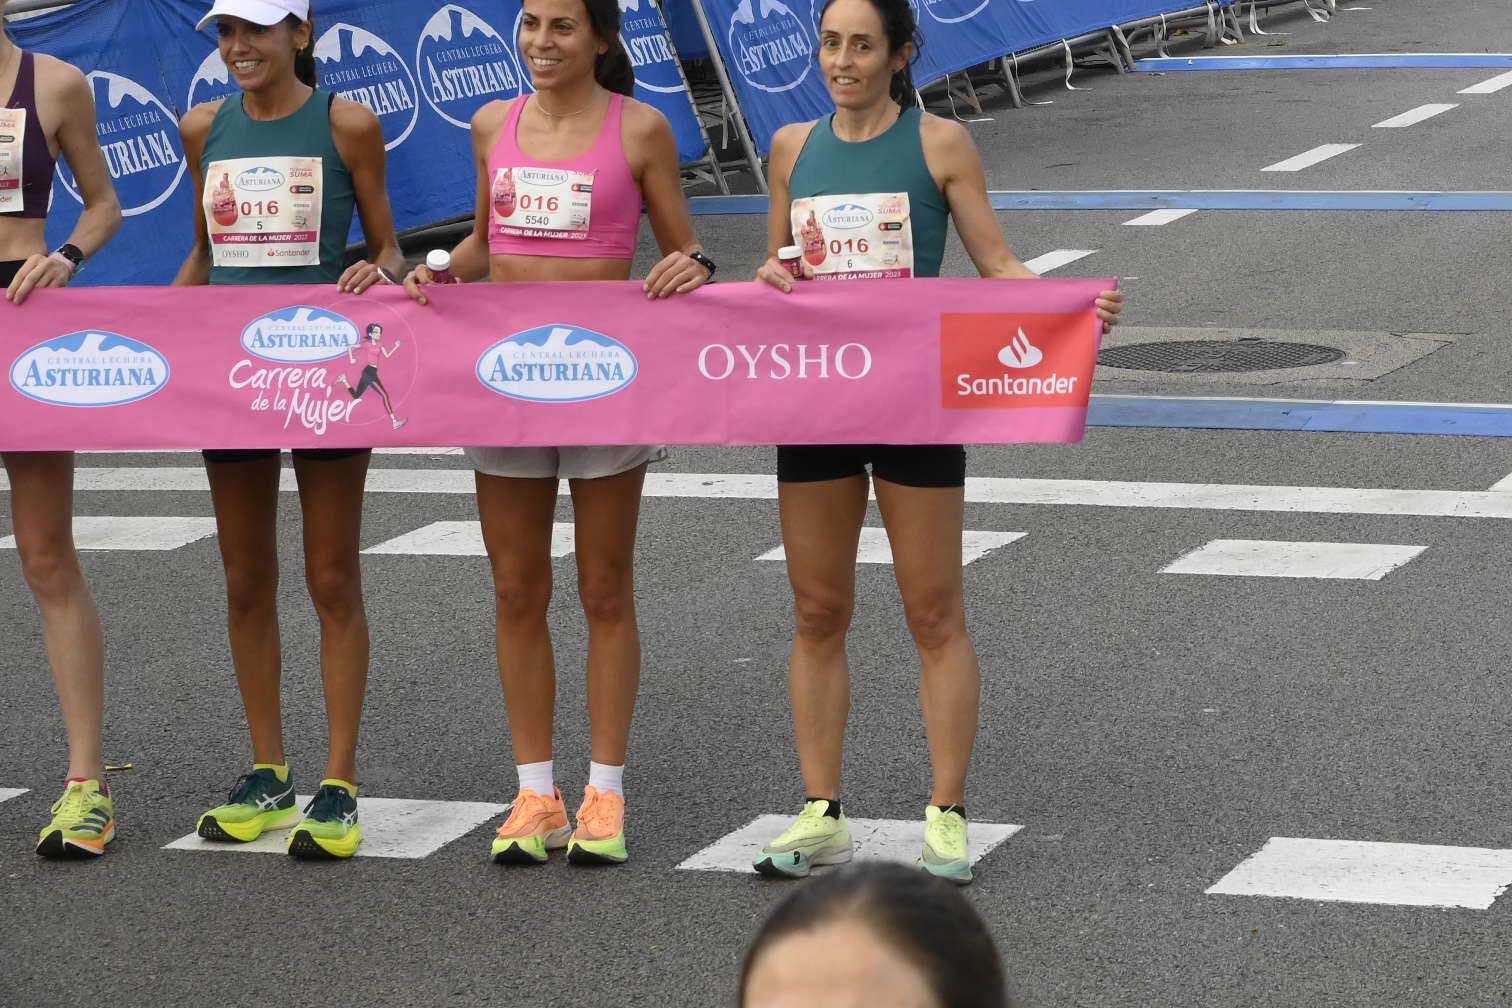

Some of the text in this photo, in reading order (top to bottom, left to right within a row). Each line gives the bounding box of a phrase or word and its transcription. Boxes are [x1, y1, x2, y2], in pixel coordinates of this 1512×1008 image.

[624, 17, 656, 32] CENTRAL
[436, 43, 503, 63] CENTRAL LECHERA
[324, 61, 399, 86] CENTRAL LECHERA
[426, 55, 518, 104] ASTURIANA
[120, 110, 162, 132] LECHERA
[101, 128, 180, 179] URIANA
[240, 176, 281, 185] ASTURIANA
[240, 200, 280, 216] 016
[520, 194, 559, 211] 016
[256, 220, 263, 231] 5
[524, 214, 550, 226] 5540
[269, 234, 291, 242] MUJER
[534, 230, 543, 238] LA
[275, 248, 310, 257] Santander
[829, 238, 869, 255] 016
[847, 259, 853, 269] 6
[848, 272, 857, 280] LA
[858, 271, 883, 280] MUJER
[251, 327, 349, 348] ASTURIANA
[513, 351, 620, 359] CENTRAL LECHERA
[698, 342, 873, 380] OYSHO
[21, 359, 157, 387] ASTURIANA
[228, 359, 326, 389] Carrera
[489, 353, 625, 382] ASTURIANA
[957, 372, 1078, 396] Santander
[251, 385, 363, 435] de la Mujer
